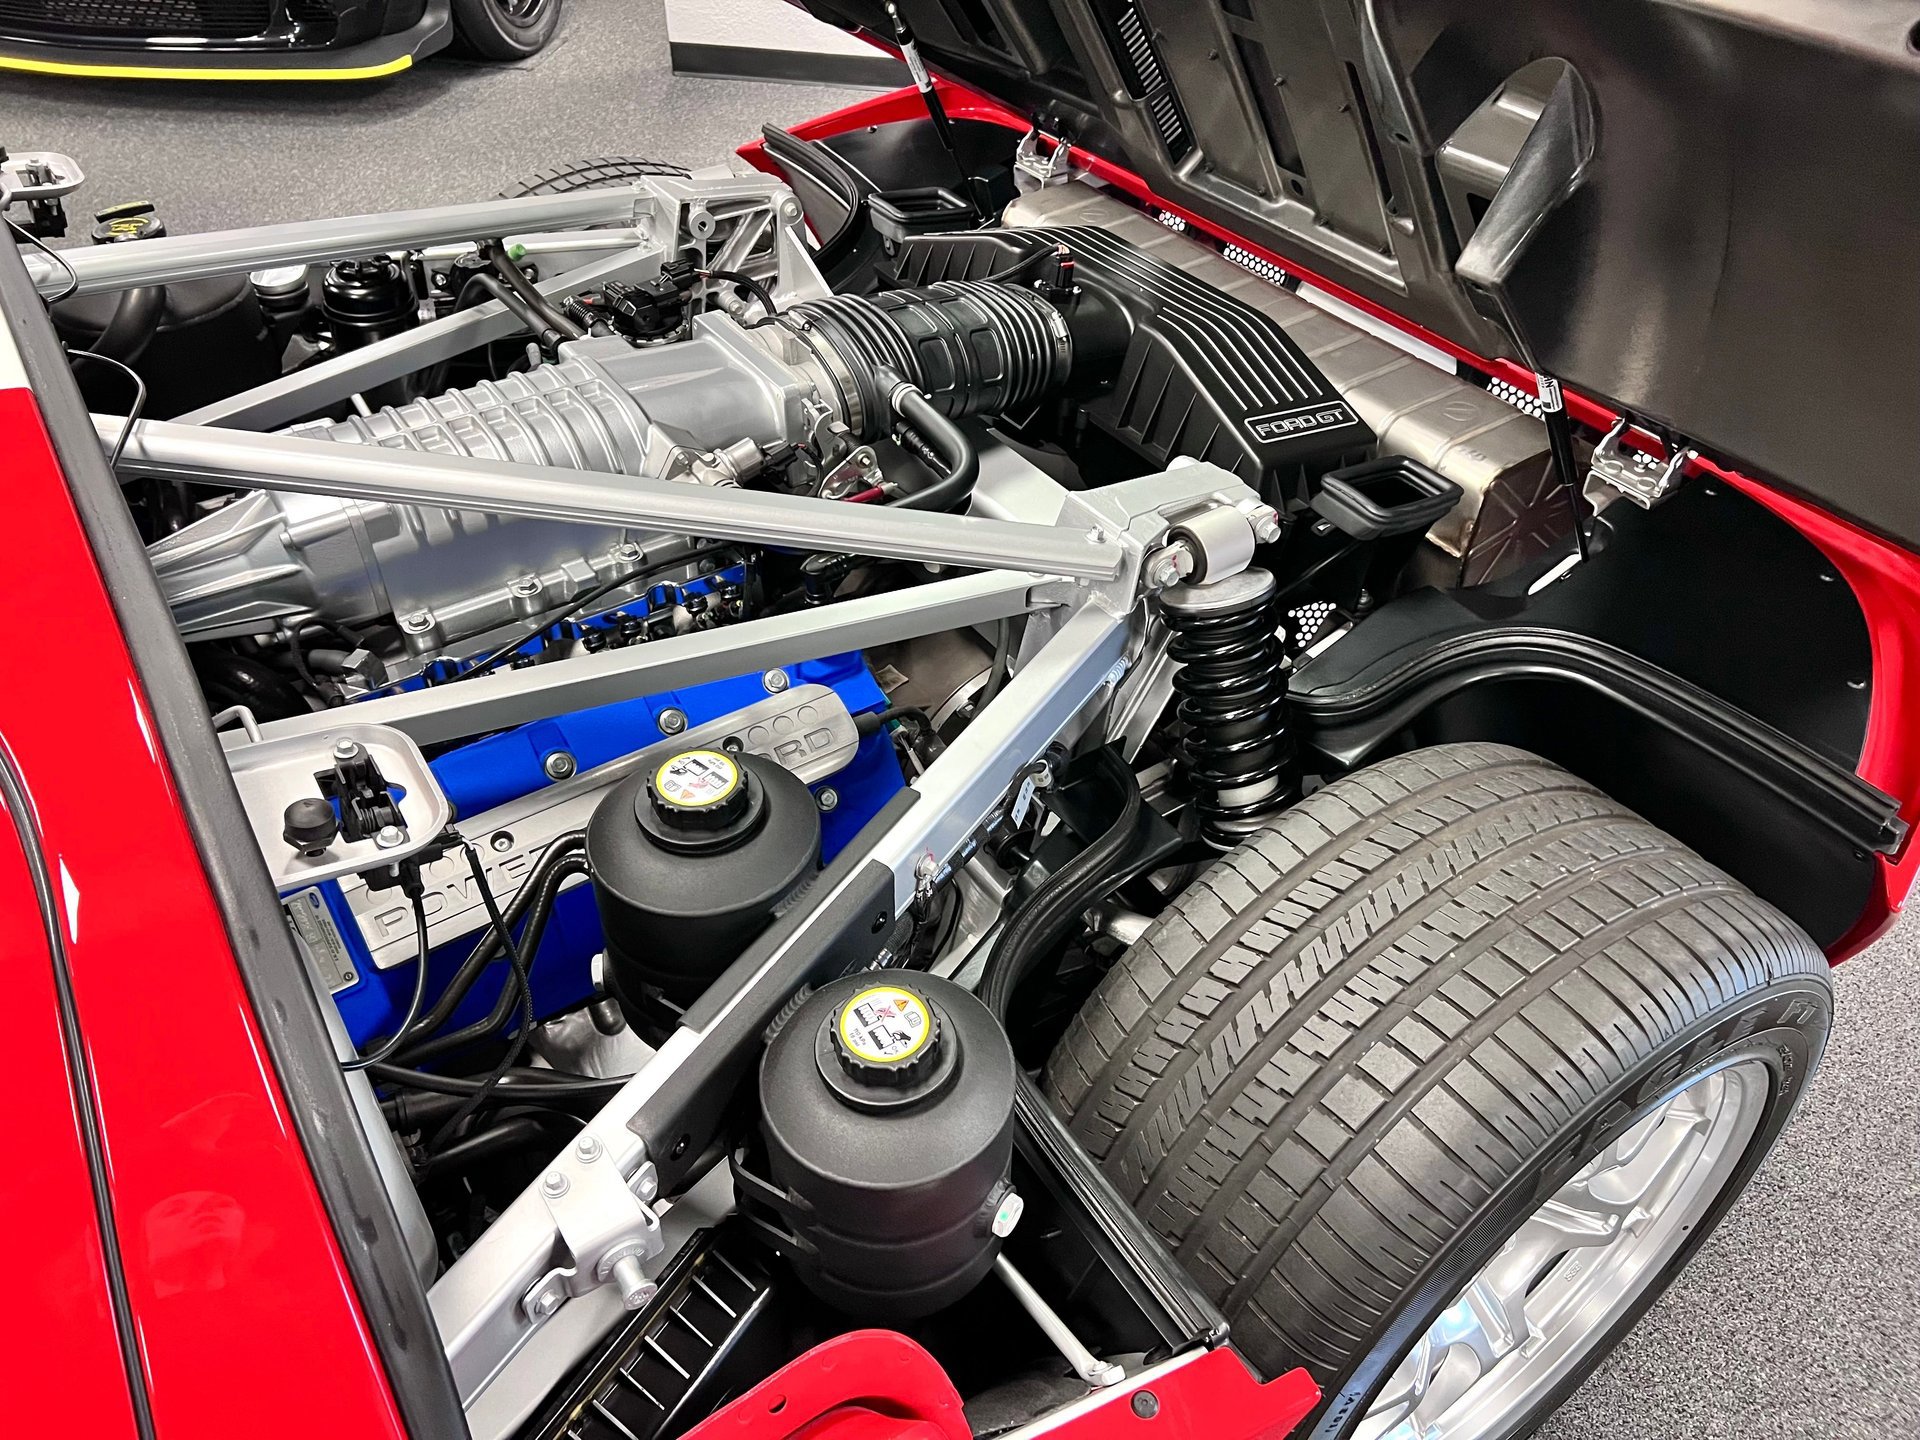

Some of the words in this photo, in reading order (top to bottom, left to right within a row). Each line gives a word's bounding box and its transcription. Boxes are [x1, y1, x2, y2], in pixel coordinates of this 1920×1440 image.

[1255, 414, 1314, 437] FORD
[1315, 408, 1343, 424] GT
[757, 727, 835, 766] RD
[373, 844, 550, 938] POWE
[1533, 1005, 1768, 1198] EAGLE
[1776, 998, 1820, 1025] F1
